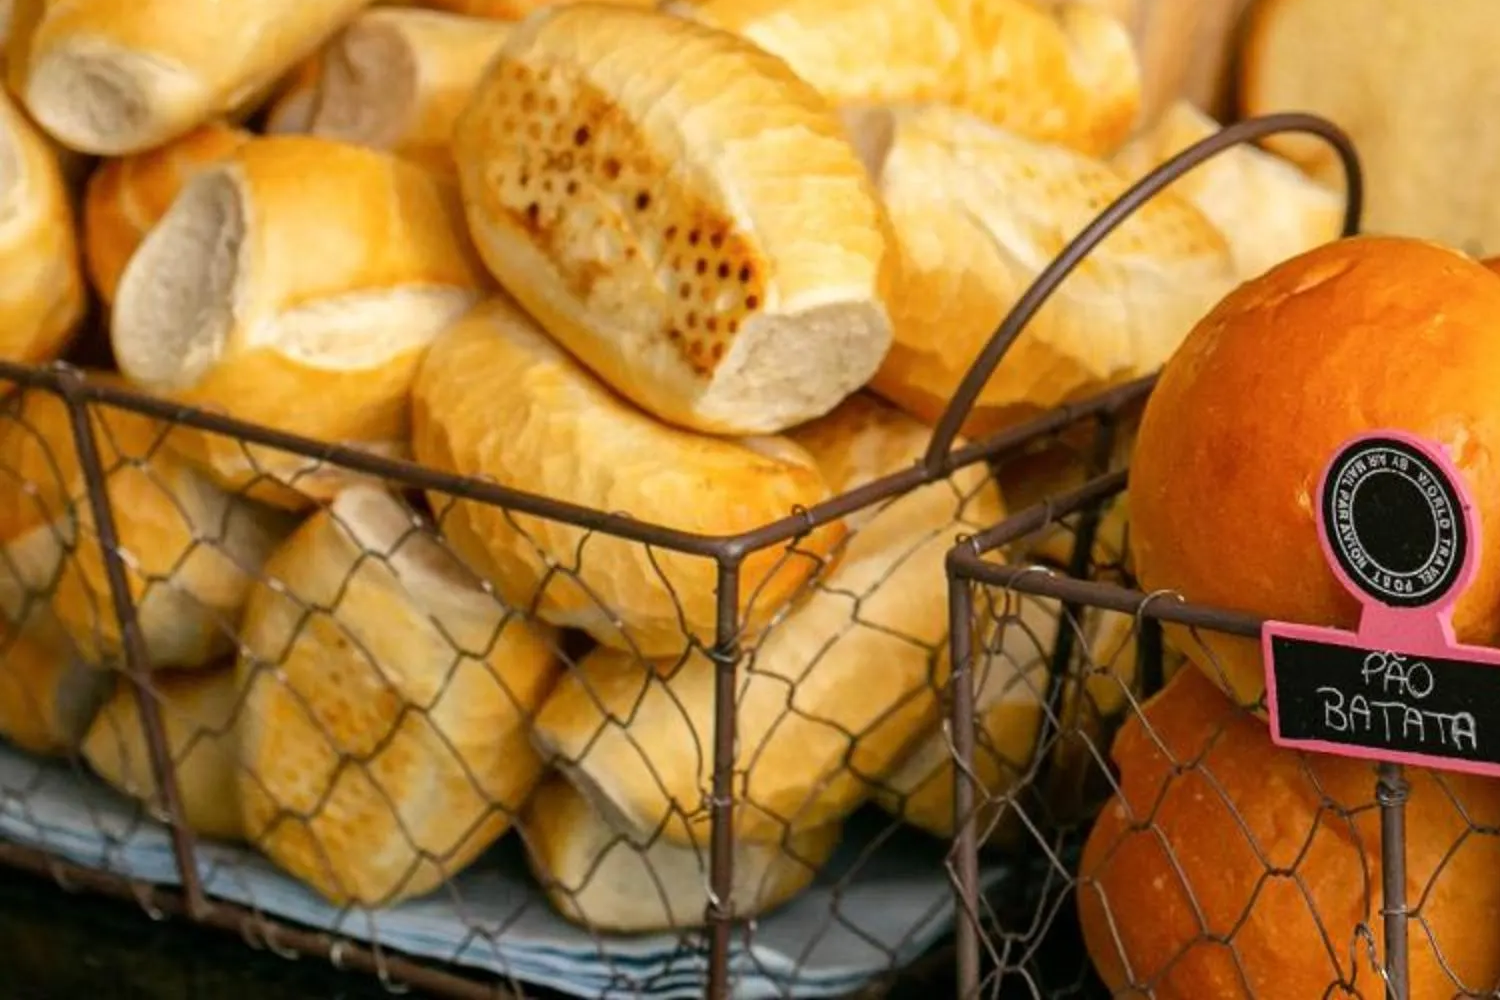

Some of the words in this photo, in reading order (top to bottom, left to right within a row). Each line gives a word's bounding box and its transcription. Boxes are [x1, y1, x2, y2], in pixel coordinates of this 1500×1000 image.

[1341, 459, 1367, 487] MAIL
[1337, 489, 1350, 520] PAR
[1418, 471, 1451, 530] WORLD
[1339, 523, 1368, 569] AVION
[1418, 539, 1452, 585] TRAVEL
[1372, 570, 1413, 593] POST
[1360, 649, 1435, 698] PÃO
[1316, 687, 1479, 751] BATATA
